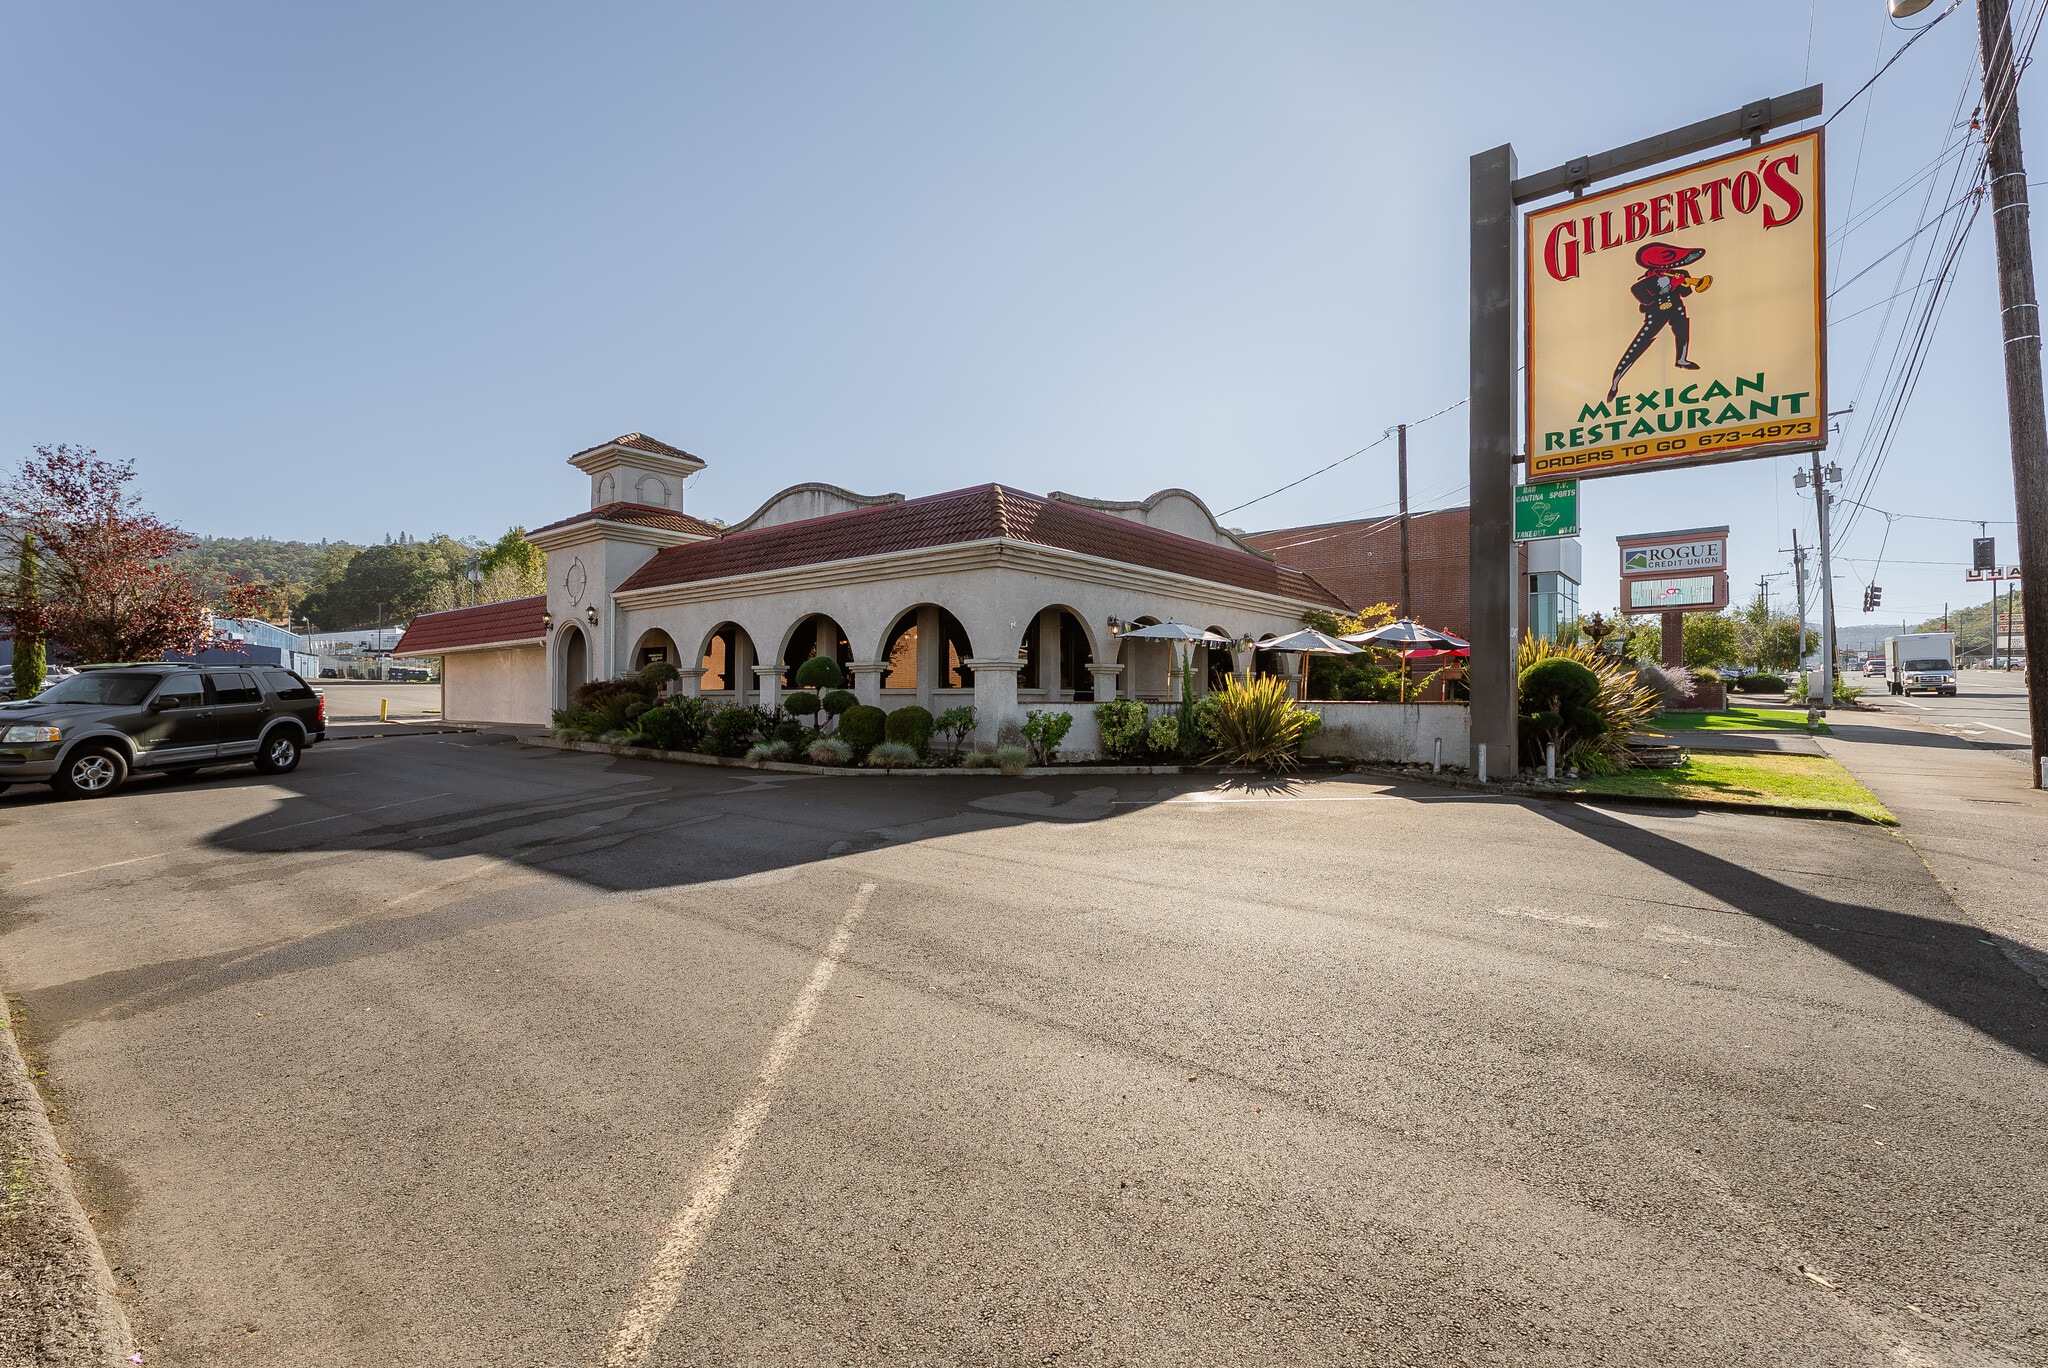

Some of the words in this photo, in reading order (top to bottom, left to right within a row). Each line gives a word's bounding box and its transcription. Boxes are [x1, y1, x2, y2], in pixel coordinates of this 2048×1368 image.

[1544, 154, 1804, 282] GILBERTO'S
[1577, 372, 1765, 423] MEXICAN
[1545, 392, 1810, 451] RESTAURANT
[1535, 452, 1614, 470] ORDERS
[1621, 445, 1648, 457] TO
[1656, 439, 1687, 450] GO
[1698, 422, 1812, 447] 673-4973
[1516, 494, 1544, 503] CANTINA
[1523, 486, 1536, 494] BAR
[1549, 490, 1576, 499] SPORTS
[1650, 543, 1718, 561] ROGUE
[1648, 560, 1683, 568] CREDIT
